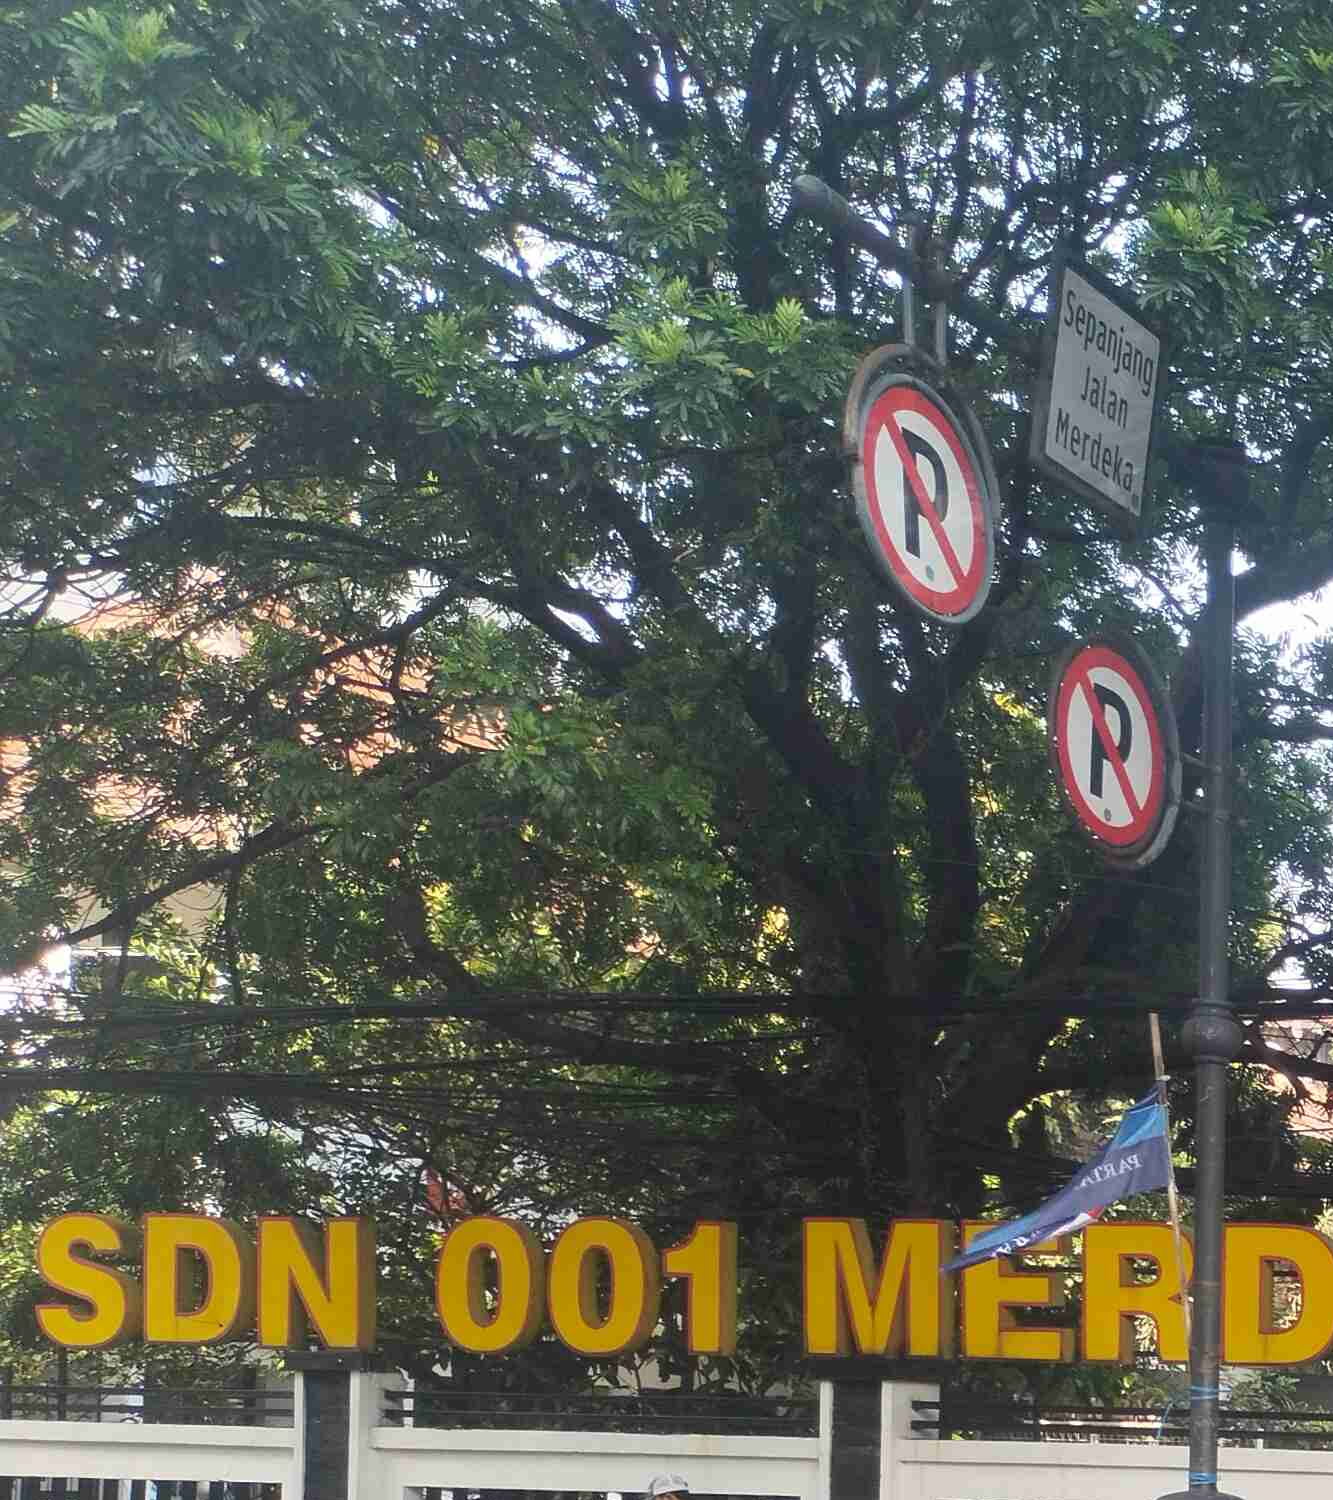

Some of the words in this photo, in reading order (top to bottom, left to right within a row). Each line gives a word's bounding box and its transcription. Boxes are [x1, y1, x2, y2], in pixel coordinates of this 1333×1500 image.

[1064, 289, 1153, 397] Sepanjang
[1081, 366, 1128, 429] Jalan
[1056, 407, 1135, 492] Merdeka
[34, 1211, 375, 1351] SDN
[436, 1215, 737, 1356] 001
